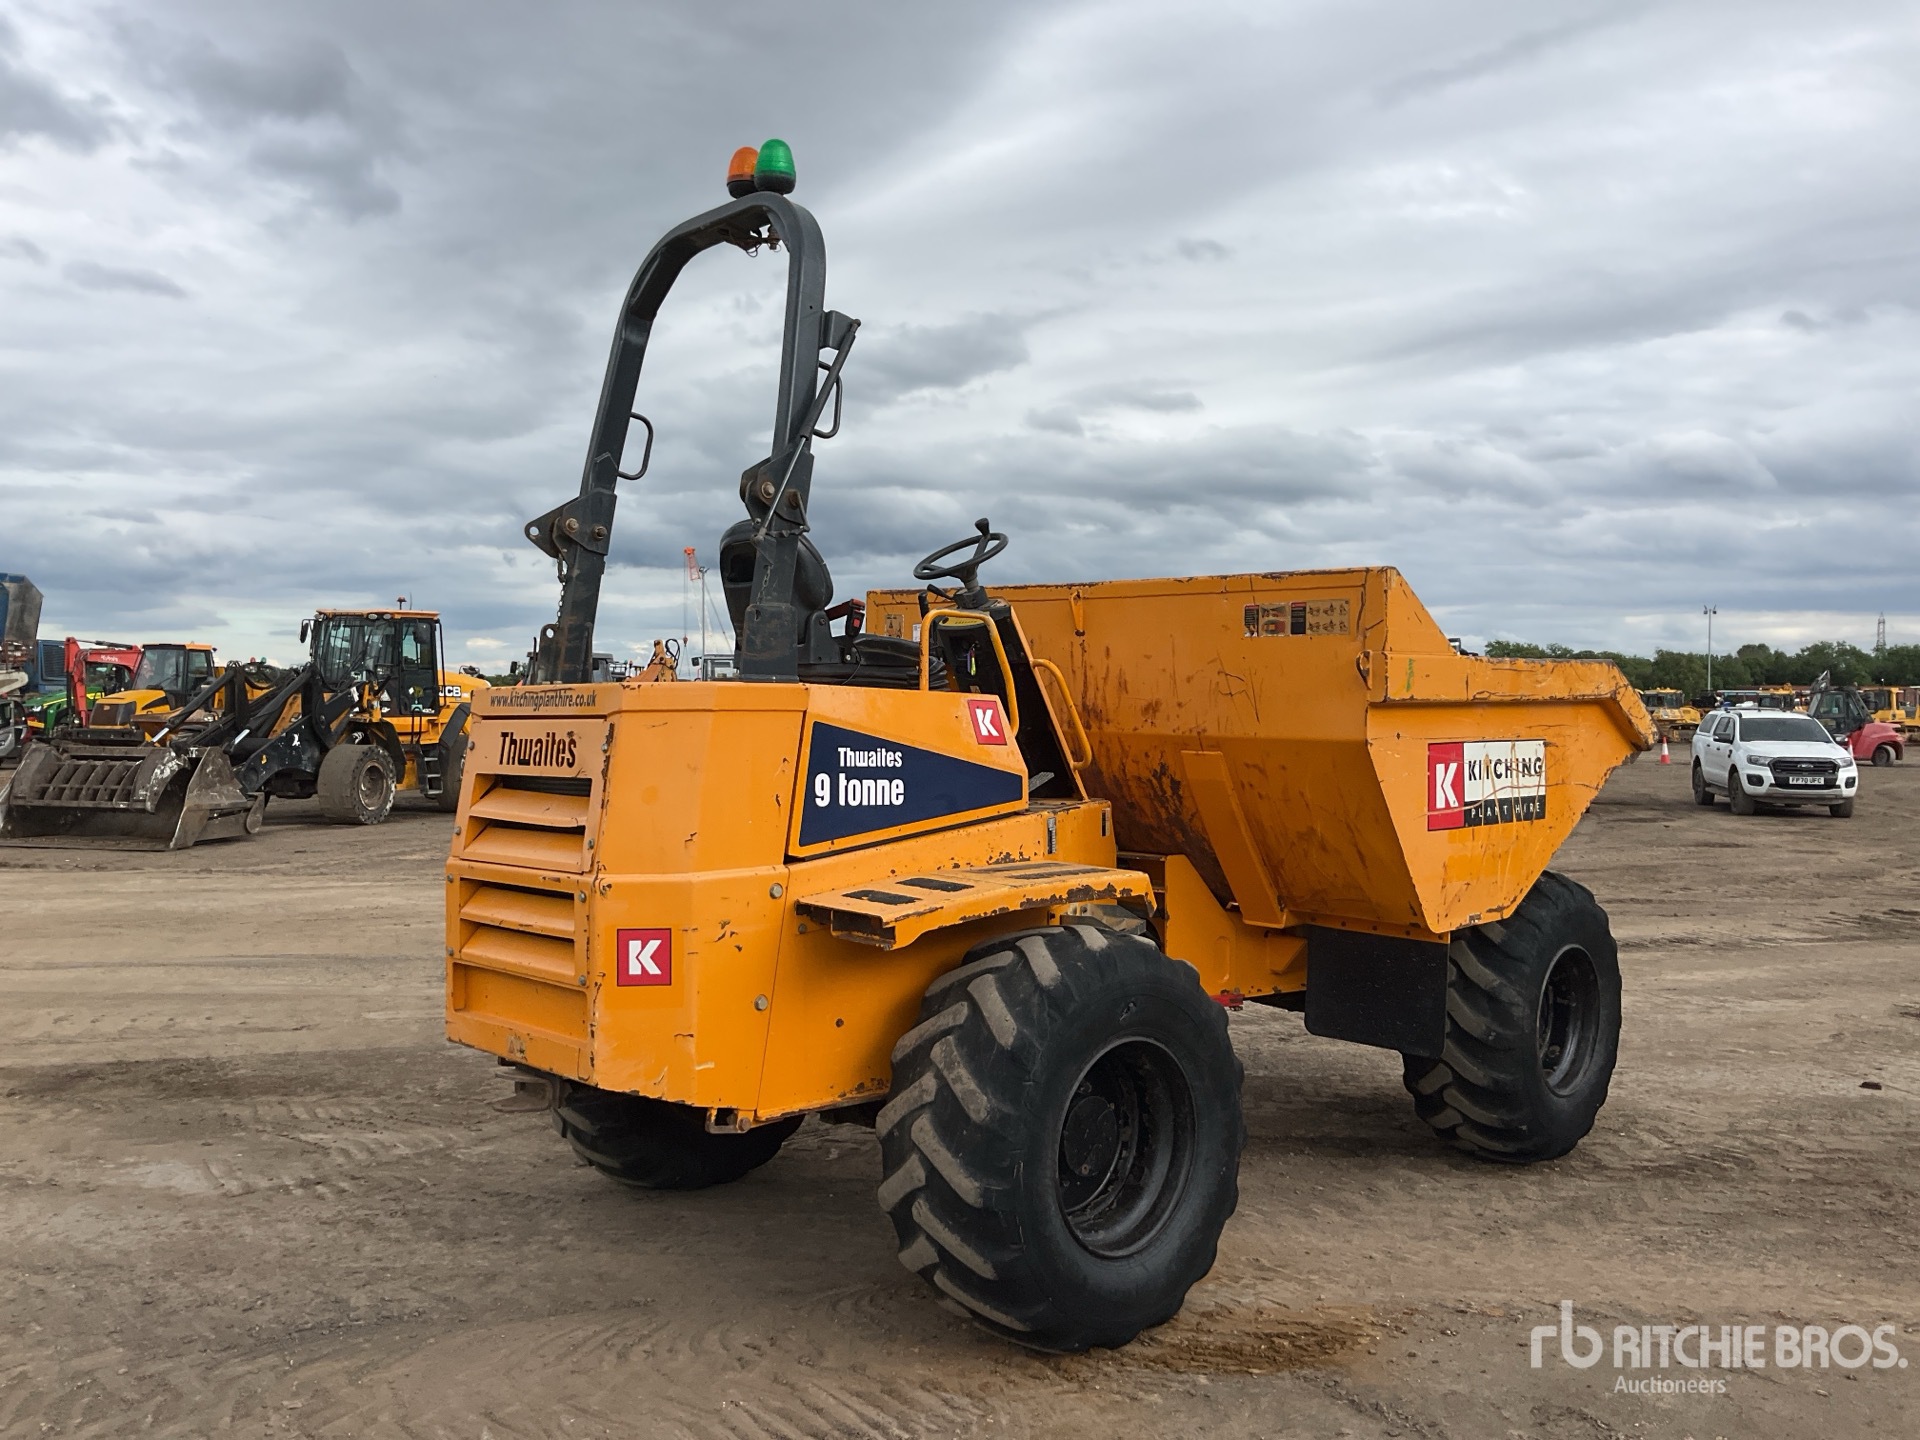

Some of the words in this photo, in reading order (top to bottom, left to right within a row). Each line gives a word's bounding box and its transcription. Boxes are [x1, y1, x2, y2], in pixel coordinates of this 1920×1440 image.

[438, 686, 461, 697] JCB
[490, 690, 597, 712] www.kitchingplanthire.co.uk
[975, 708, 1000, 737] K
[499, 731, 577, 768] Thwaites
[837, 747, 903, 768] Thwaites
[1468, 756, 1543, 781] KITCHING
[814, 772, 831, 808] 9
[838, 772, 905, 806] tonne
[1435, 762, 1459, 809] K
[628, 939, 662, 975] K
